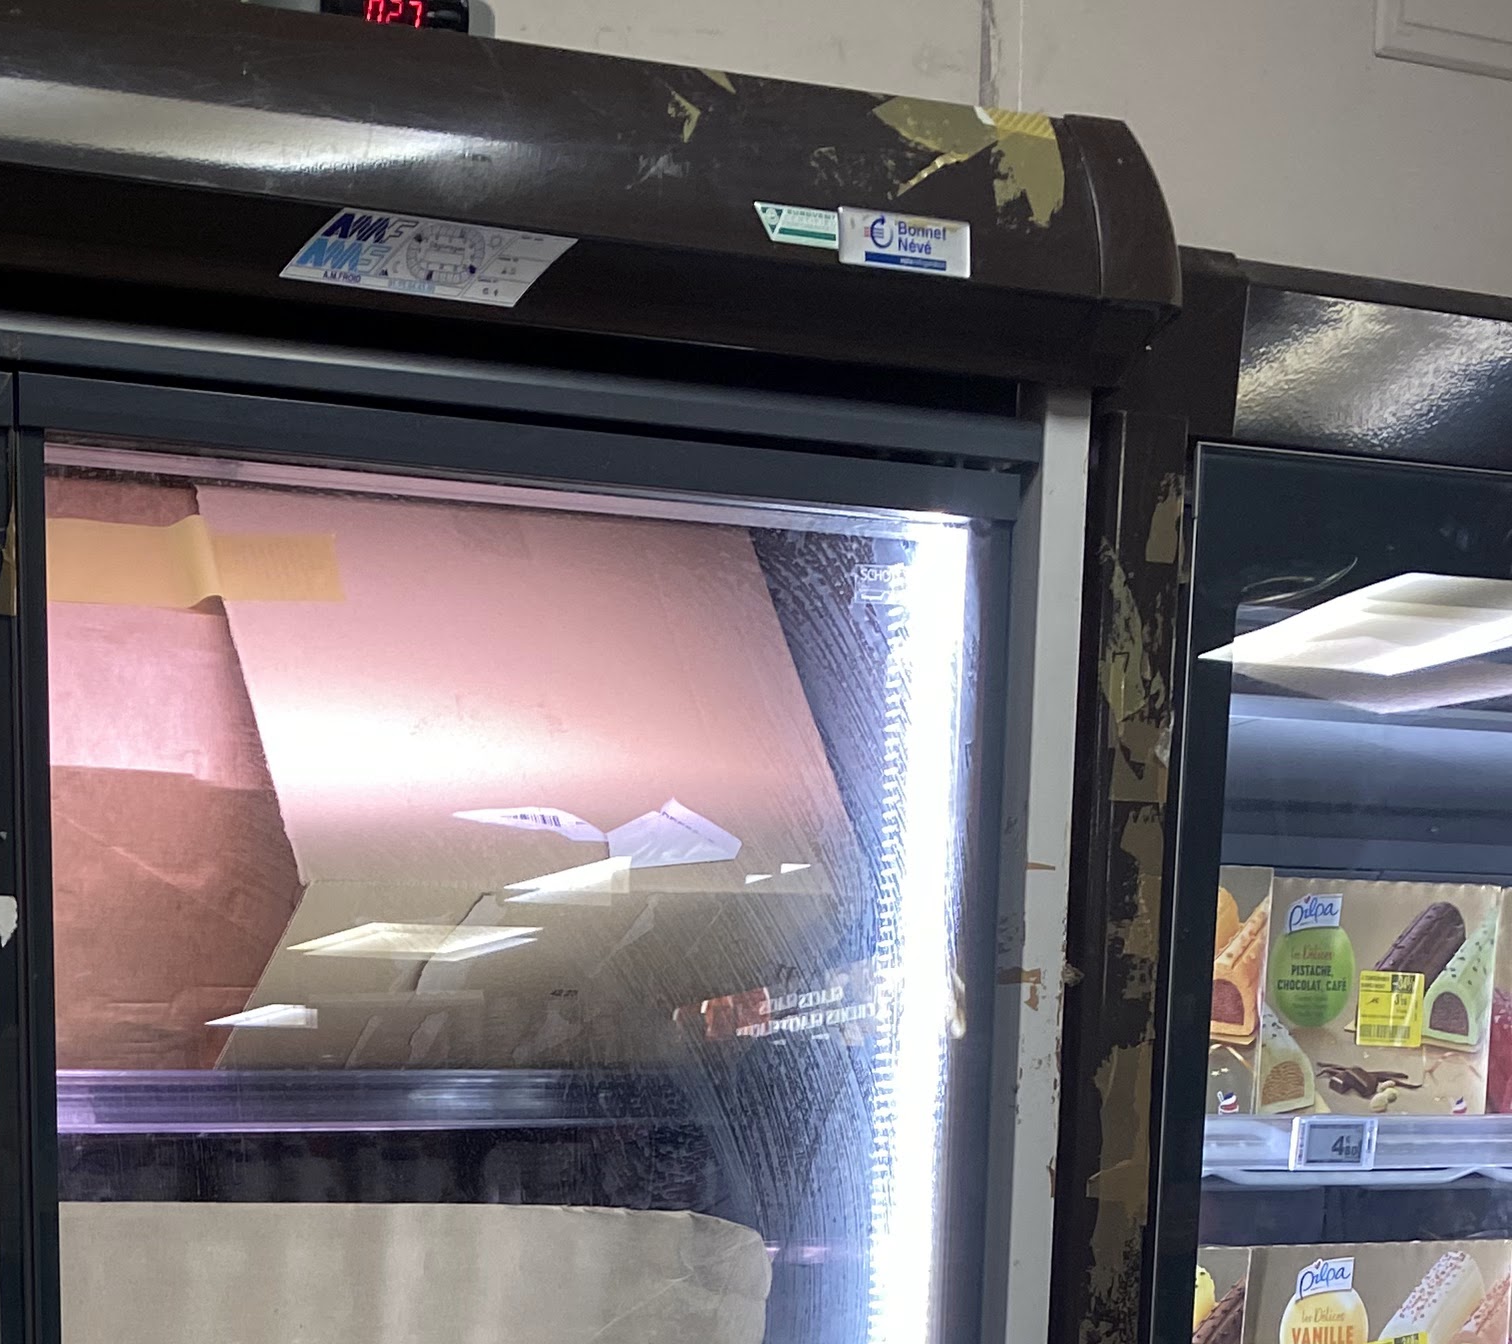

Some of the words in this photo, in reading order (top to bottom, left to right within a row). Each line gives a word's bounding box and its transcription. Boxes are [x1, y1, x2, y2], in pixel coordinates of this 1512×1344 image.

[898, 220, 947, 241] Bonnet
[898, 236, 932, 255] Névé
[1325, 977, 1347, 992] CAFÉ
